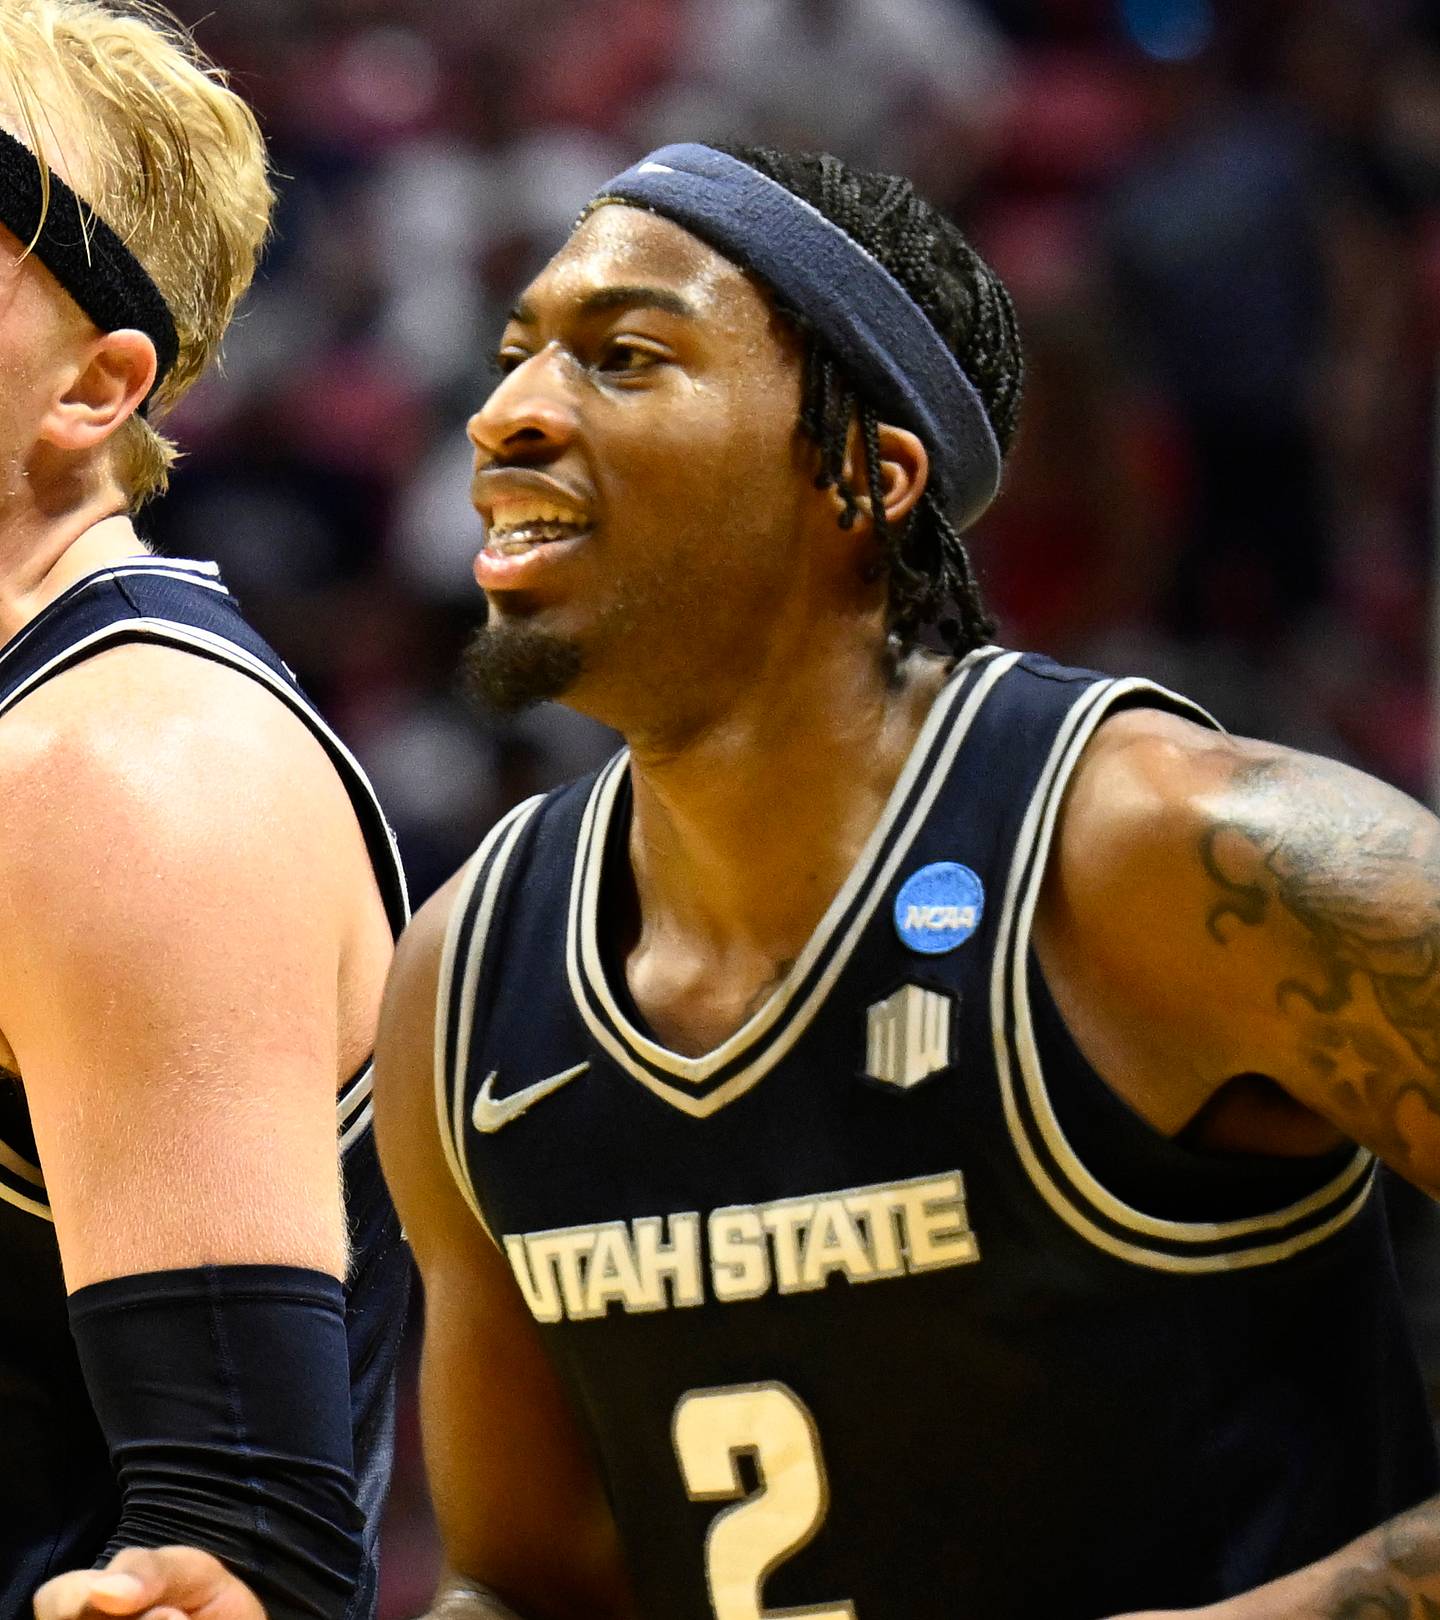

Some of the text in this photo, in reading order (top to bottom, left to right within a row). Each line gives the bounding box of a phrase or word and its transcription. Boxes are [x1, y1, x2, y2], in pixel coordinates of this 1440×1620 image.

[904, 905, 976, 929] NCAA
[502, 1169, 980, 1324] UTAH STATE
[671, 1380, 858, 1620] 2
